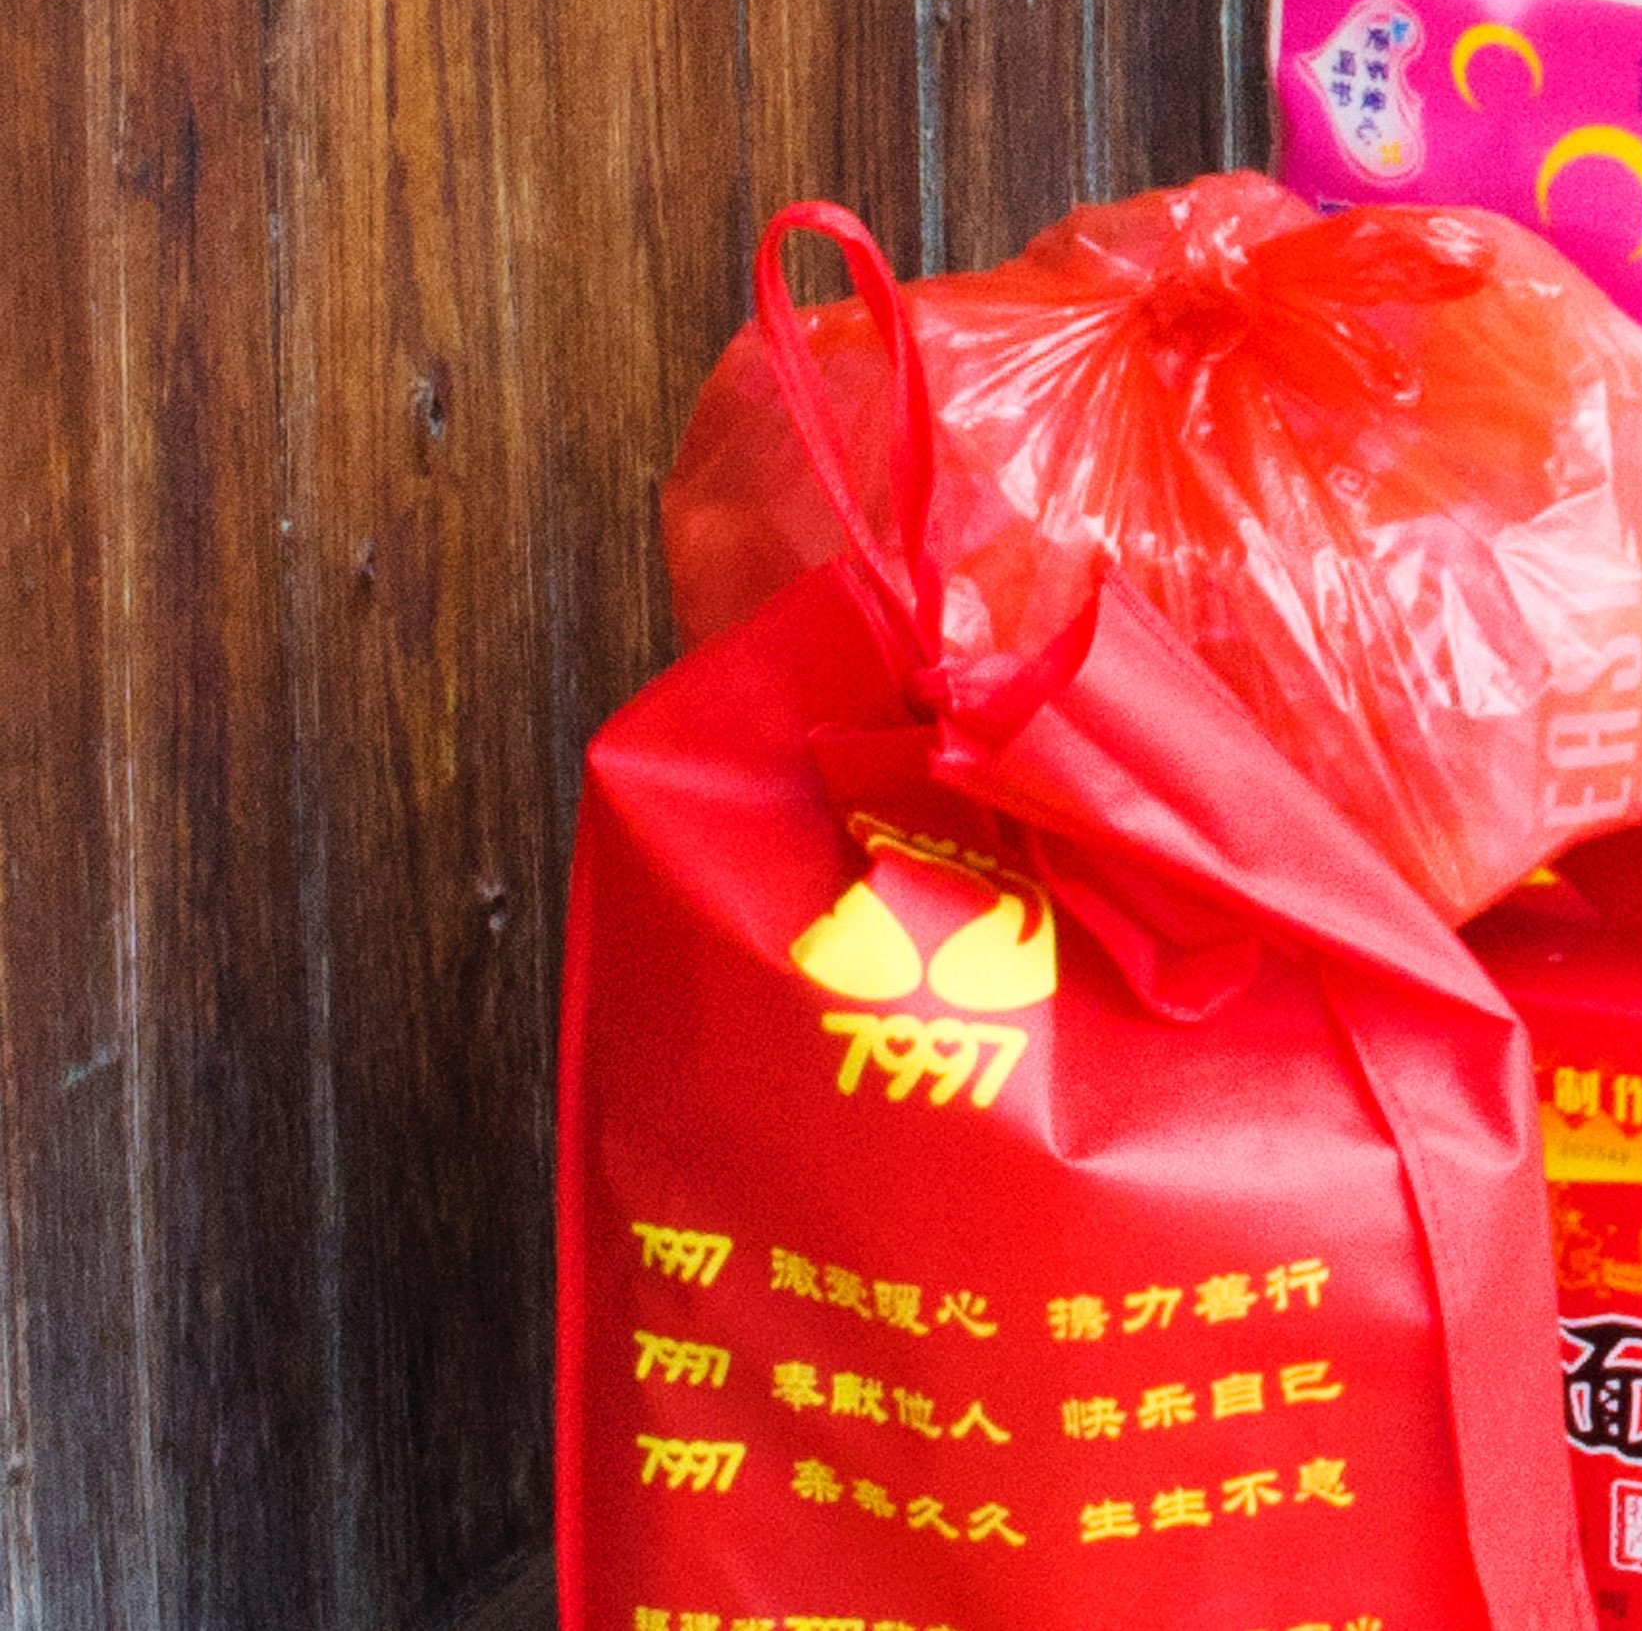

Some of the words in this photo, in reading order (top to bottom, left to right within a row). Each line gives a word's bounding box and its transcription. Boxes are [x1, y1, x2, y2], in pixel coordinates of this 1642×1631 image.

[1061, 1360, 1344, 1440] 快乐自己
[1080, 1456, 1355, 1544] 生生不息
